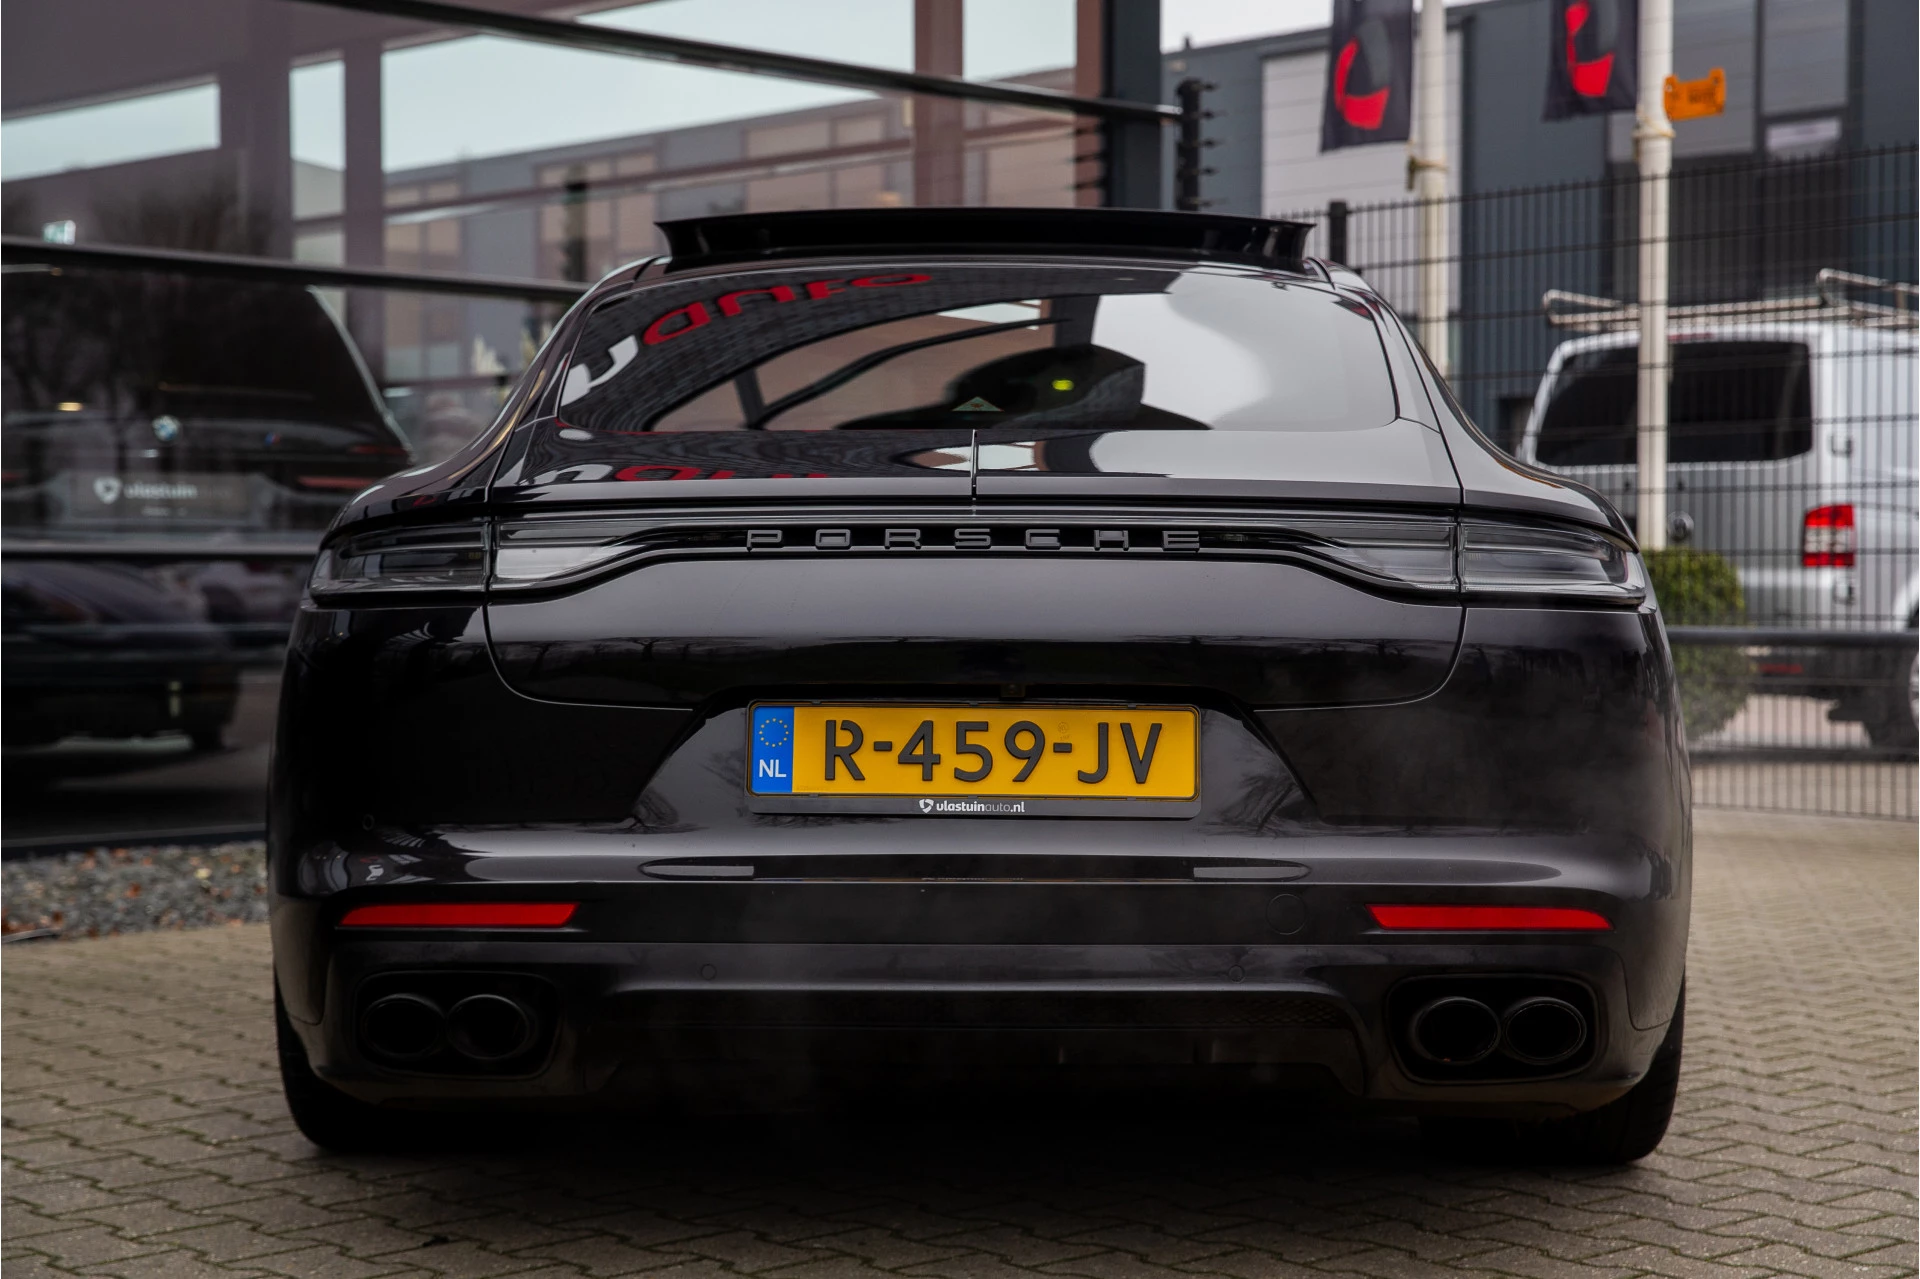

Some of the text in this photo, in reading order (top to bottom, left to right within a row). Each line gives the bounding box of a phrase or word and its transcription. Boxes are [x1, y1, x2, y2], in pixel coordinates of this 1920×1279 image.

[746, 528, 1201, 552] PORSCHE
[824, 719, 1162, 785] R-459-JV
[758, 758, 787, 778] NL
